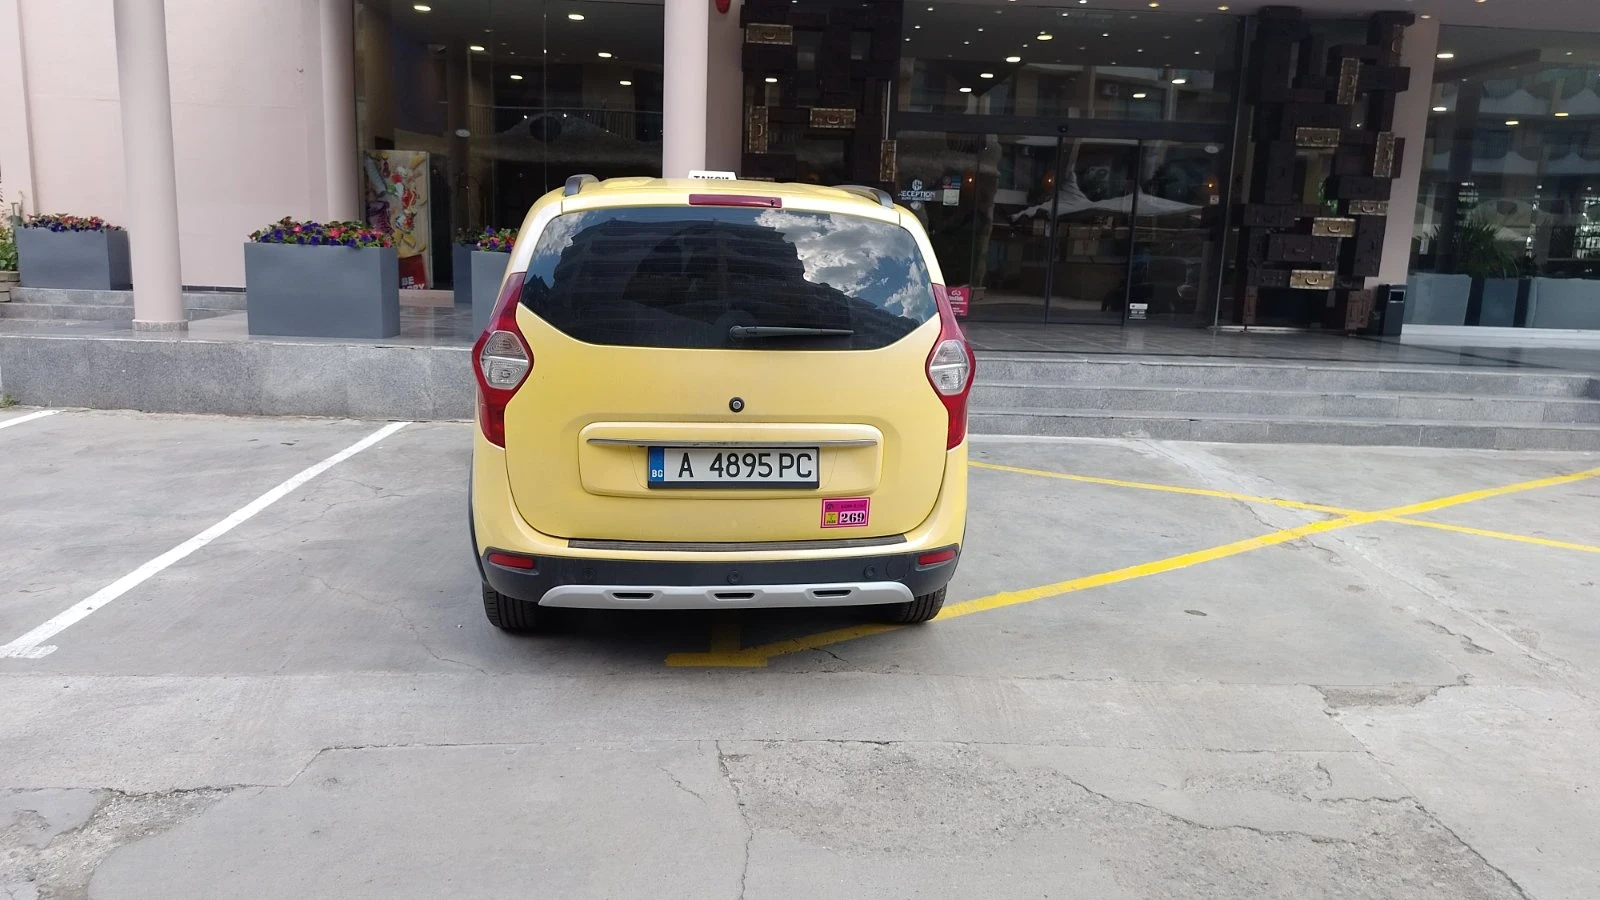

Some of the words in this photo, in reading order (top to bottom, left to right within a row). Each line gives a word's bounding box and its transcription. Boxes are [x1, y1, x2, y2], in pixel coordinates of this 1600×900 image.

[651, 469, 664, 478] BG
[678, 452, 694, 478] A
[709, 452, 773, 478] 4895
[840, 512, 865, 523] 269
